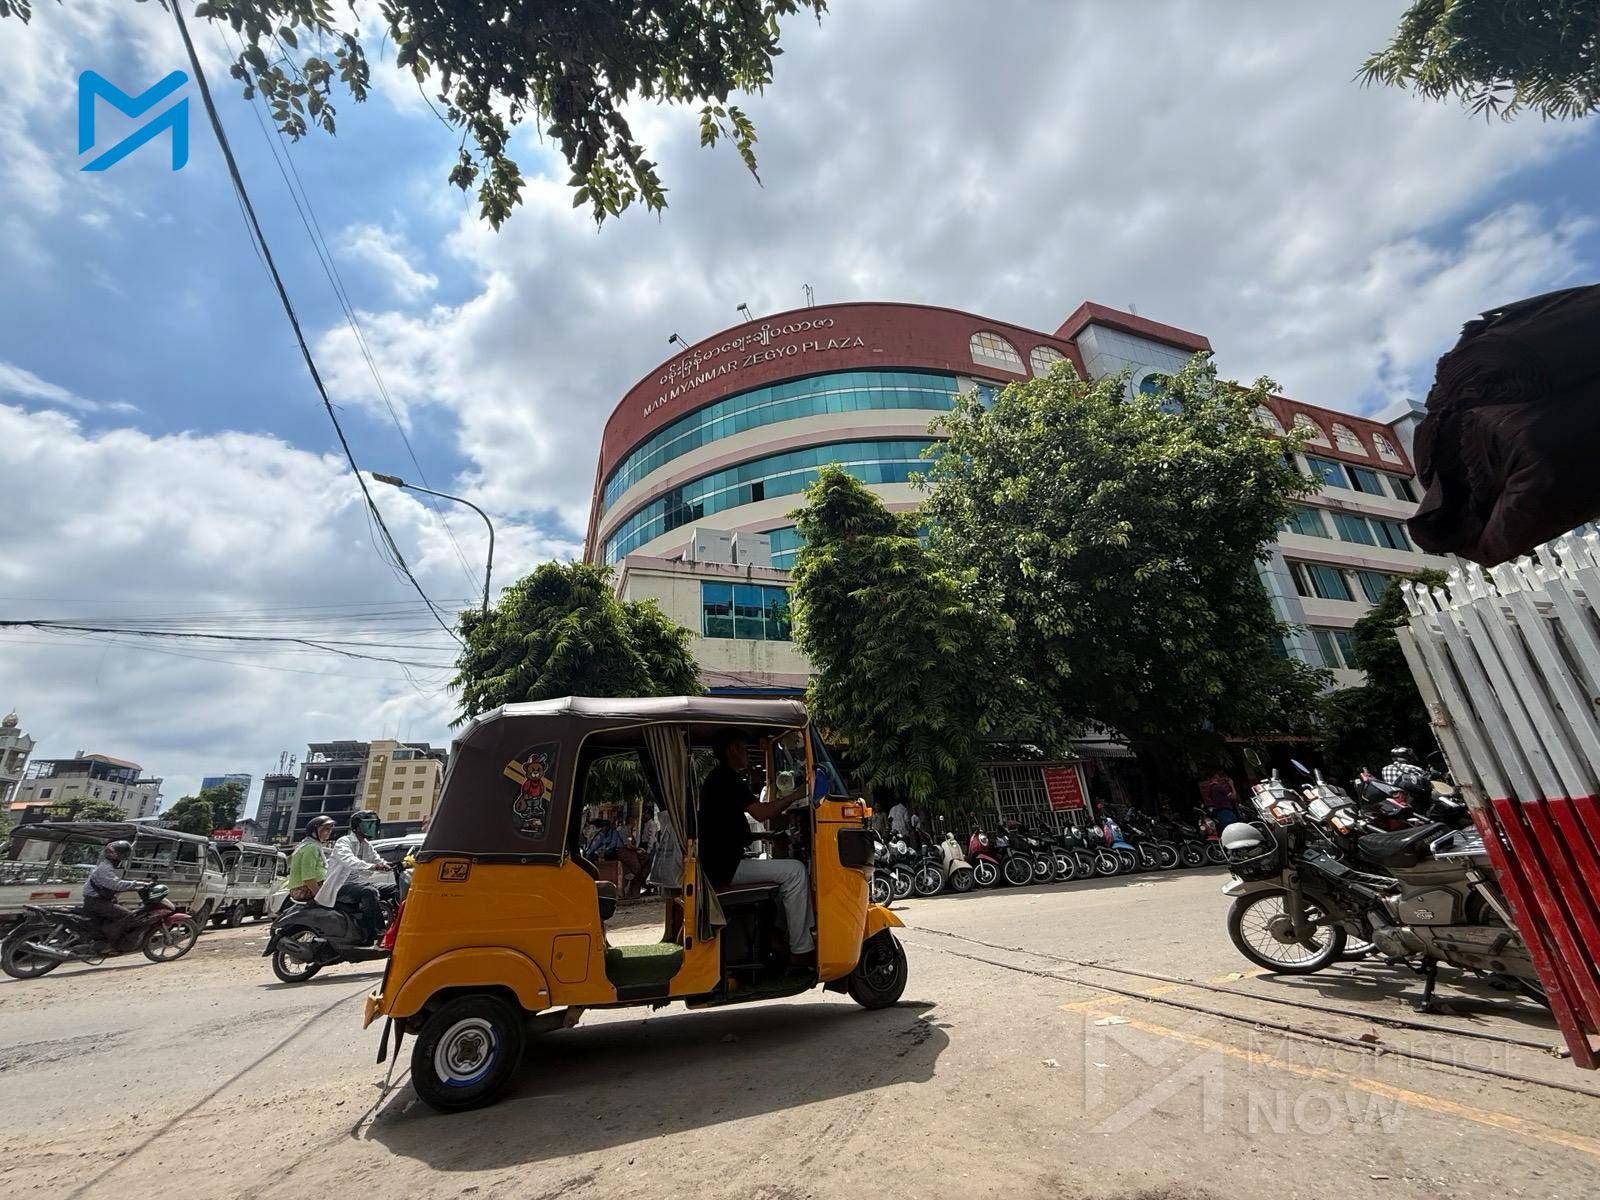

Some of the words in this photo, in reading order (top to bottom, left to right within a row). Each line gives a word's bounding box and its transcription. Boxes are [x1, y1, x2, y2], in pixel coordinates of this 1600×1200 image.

[643, 393, 669, 418] MAN
[670, 360, 739, 399] MYANMAR
[742, 344, 798, 368] ZEGYO
[801, 335, 866, 353] PLAZA
